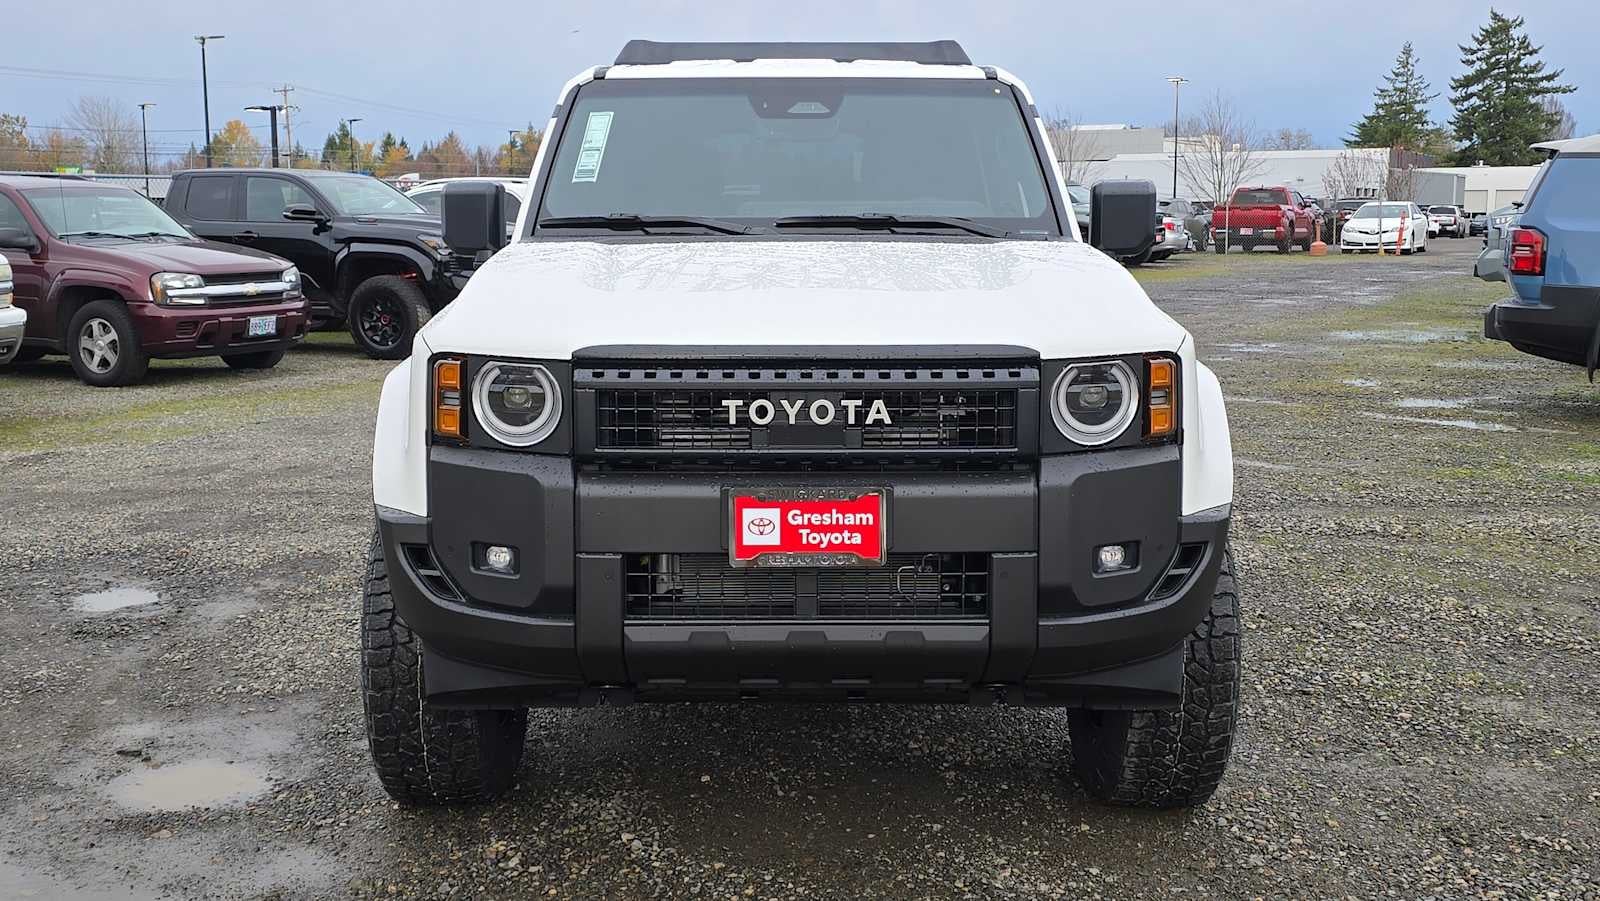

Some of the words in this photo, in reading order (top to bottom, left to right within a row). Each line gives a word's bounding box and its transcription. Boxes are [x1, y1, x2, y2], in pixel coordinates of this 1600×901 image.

[721, 399, 892, 425] TOYOTA
[787, 508, 874, 526] Gresham
[799, 529, 862, 548] Toyota
